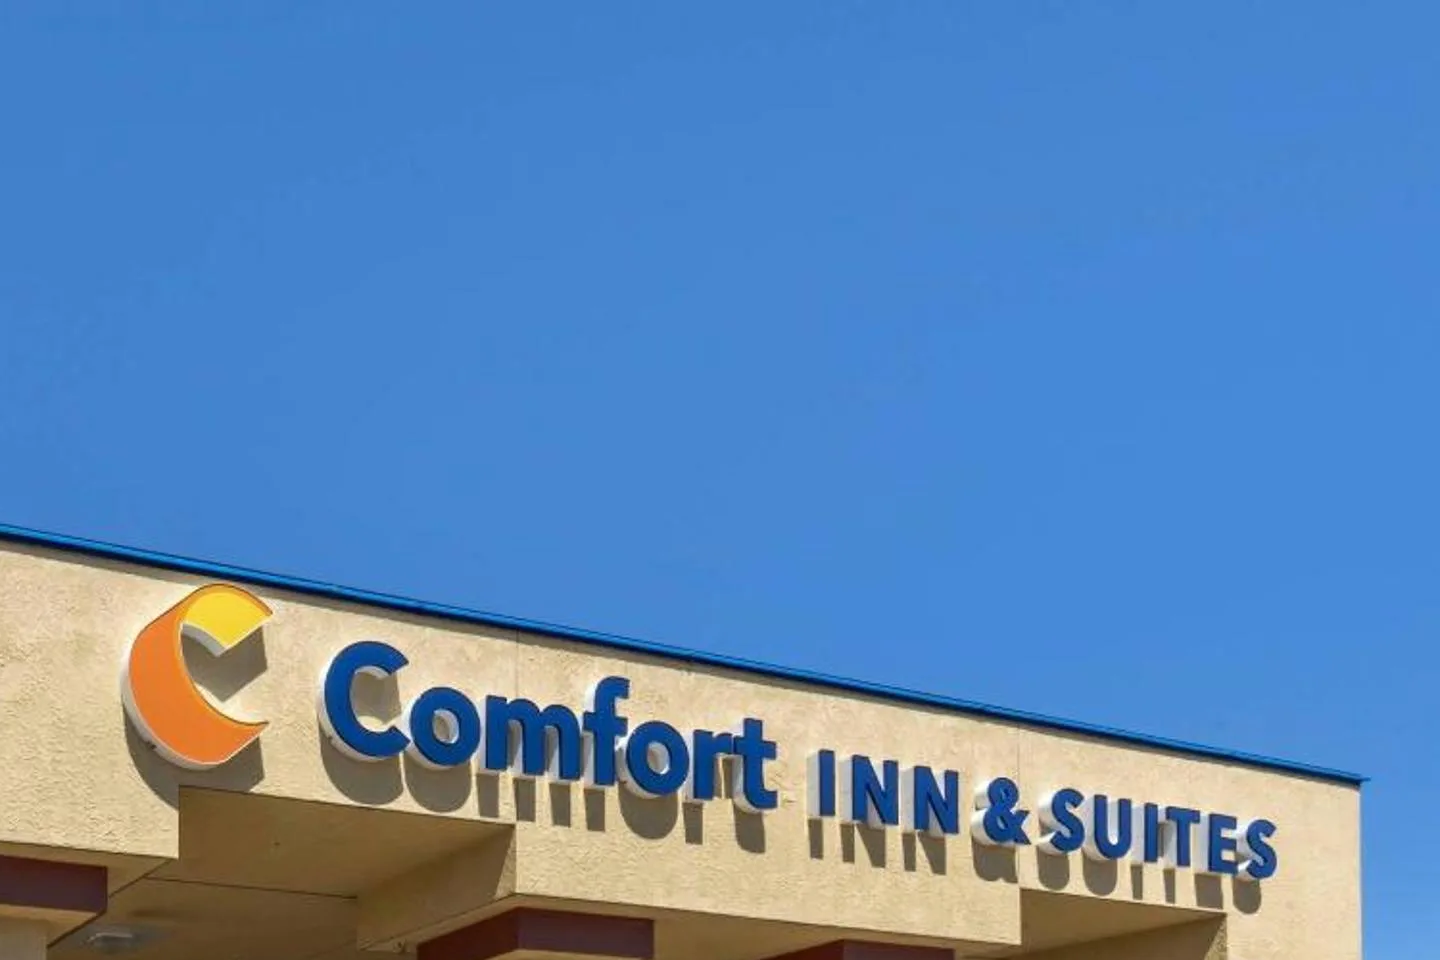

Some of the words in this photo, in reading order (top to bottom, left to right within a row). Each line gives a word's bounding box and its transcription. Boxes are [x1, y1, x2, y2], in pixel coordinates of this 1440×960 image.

[322, 640, 778, 811] Comfort
[814, 748, 960, 835] INN
[979, 776, 1032, 845] &
[1047, 787, 1278, 880] SUITES
